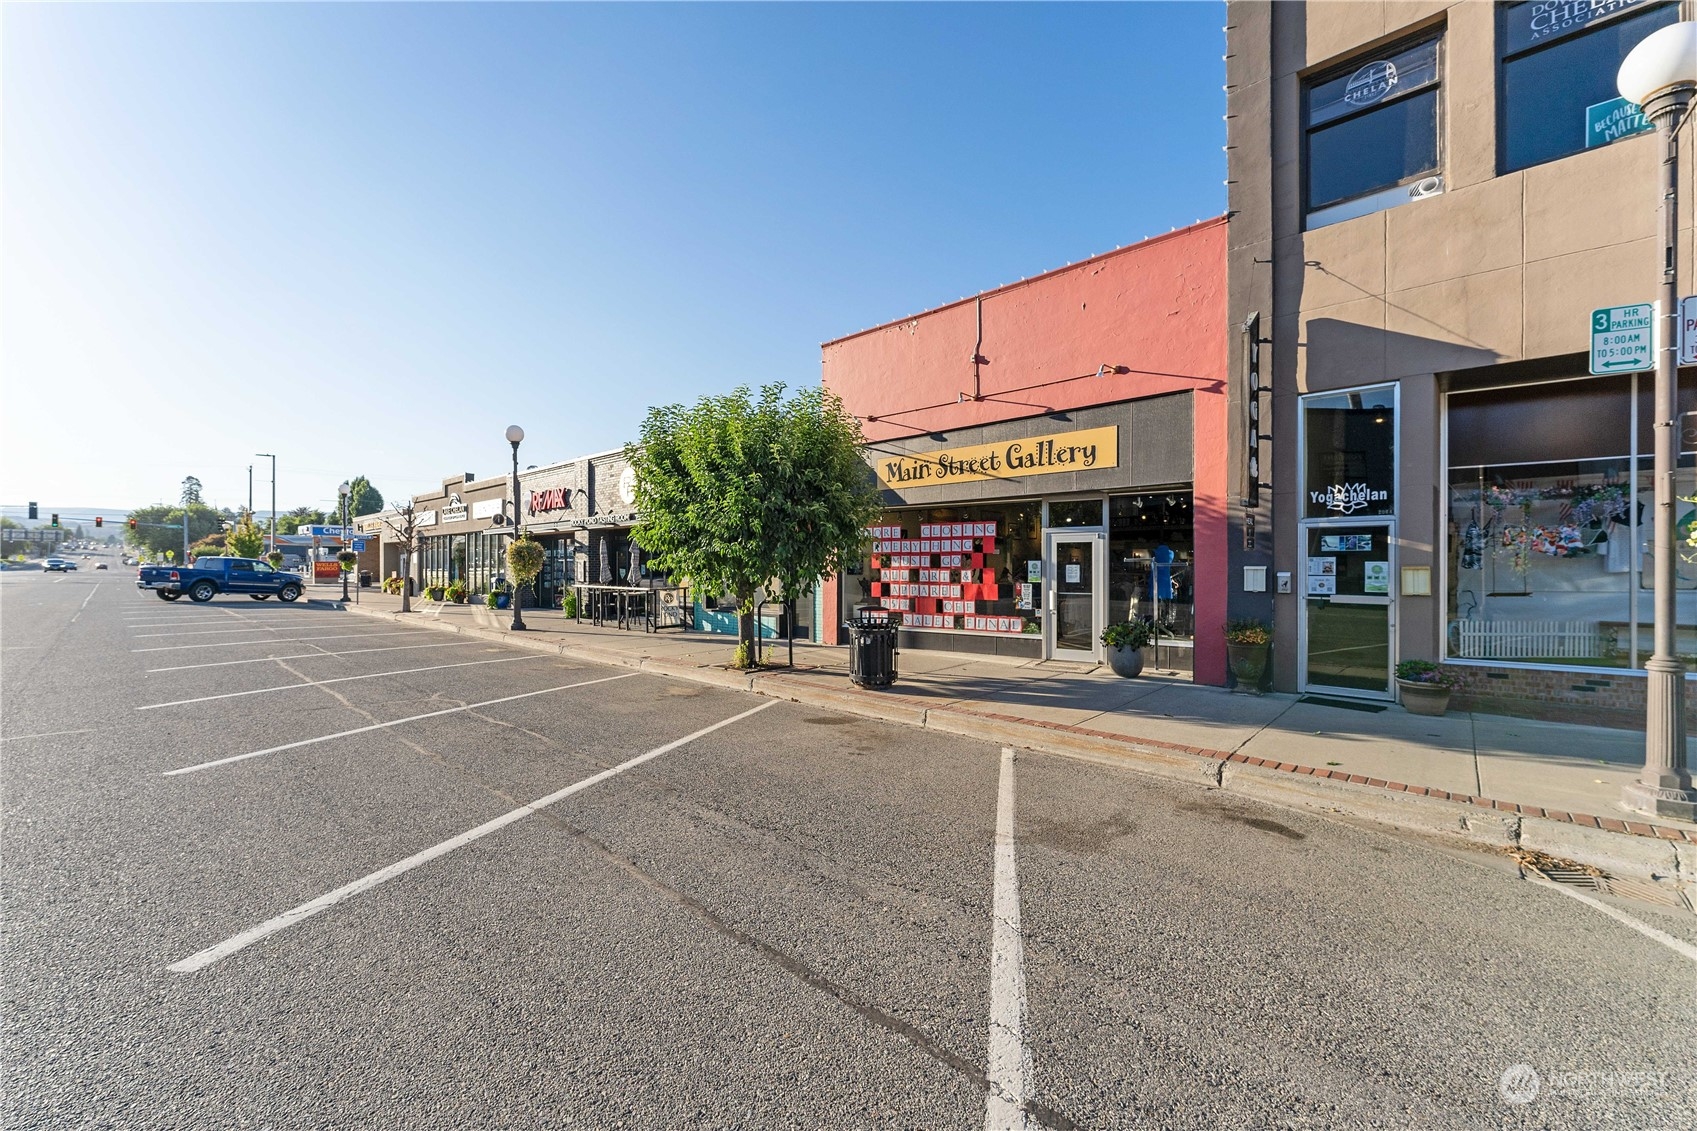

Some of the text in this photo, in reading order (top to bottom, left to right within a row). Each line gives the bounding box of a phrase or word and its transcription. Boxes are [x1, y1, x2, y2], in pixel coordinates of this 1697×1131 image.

[1345, 77, 1398, 101] CHELAN
[1595, 103, 1637, 132] BECAUSE
[1605, 113, 1649, 141] MATTE
[1595, 307, 1639, 330] 3 HR
[1611, 317, 1650, 329] PARKING
[1597, 345, 1647, 358] TO 5:00 PM
[885, 438, 1097, 483] Main Street Gallery
[922, 523, 995, 537] CLOSING
[891, 555, 961, 566] MUST GO
[882, 570, 970, 581] ALL ART &
[892, 586, 960, 597] APPAREL
[882, 599, 973, 612] 25% OFF
[905, 614, 1021, 630] SALES FINAL
